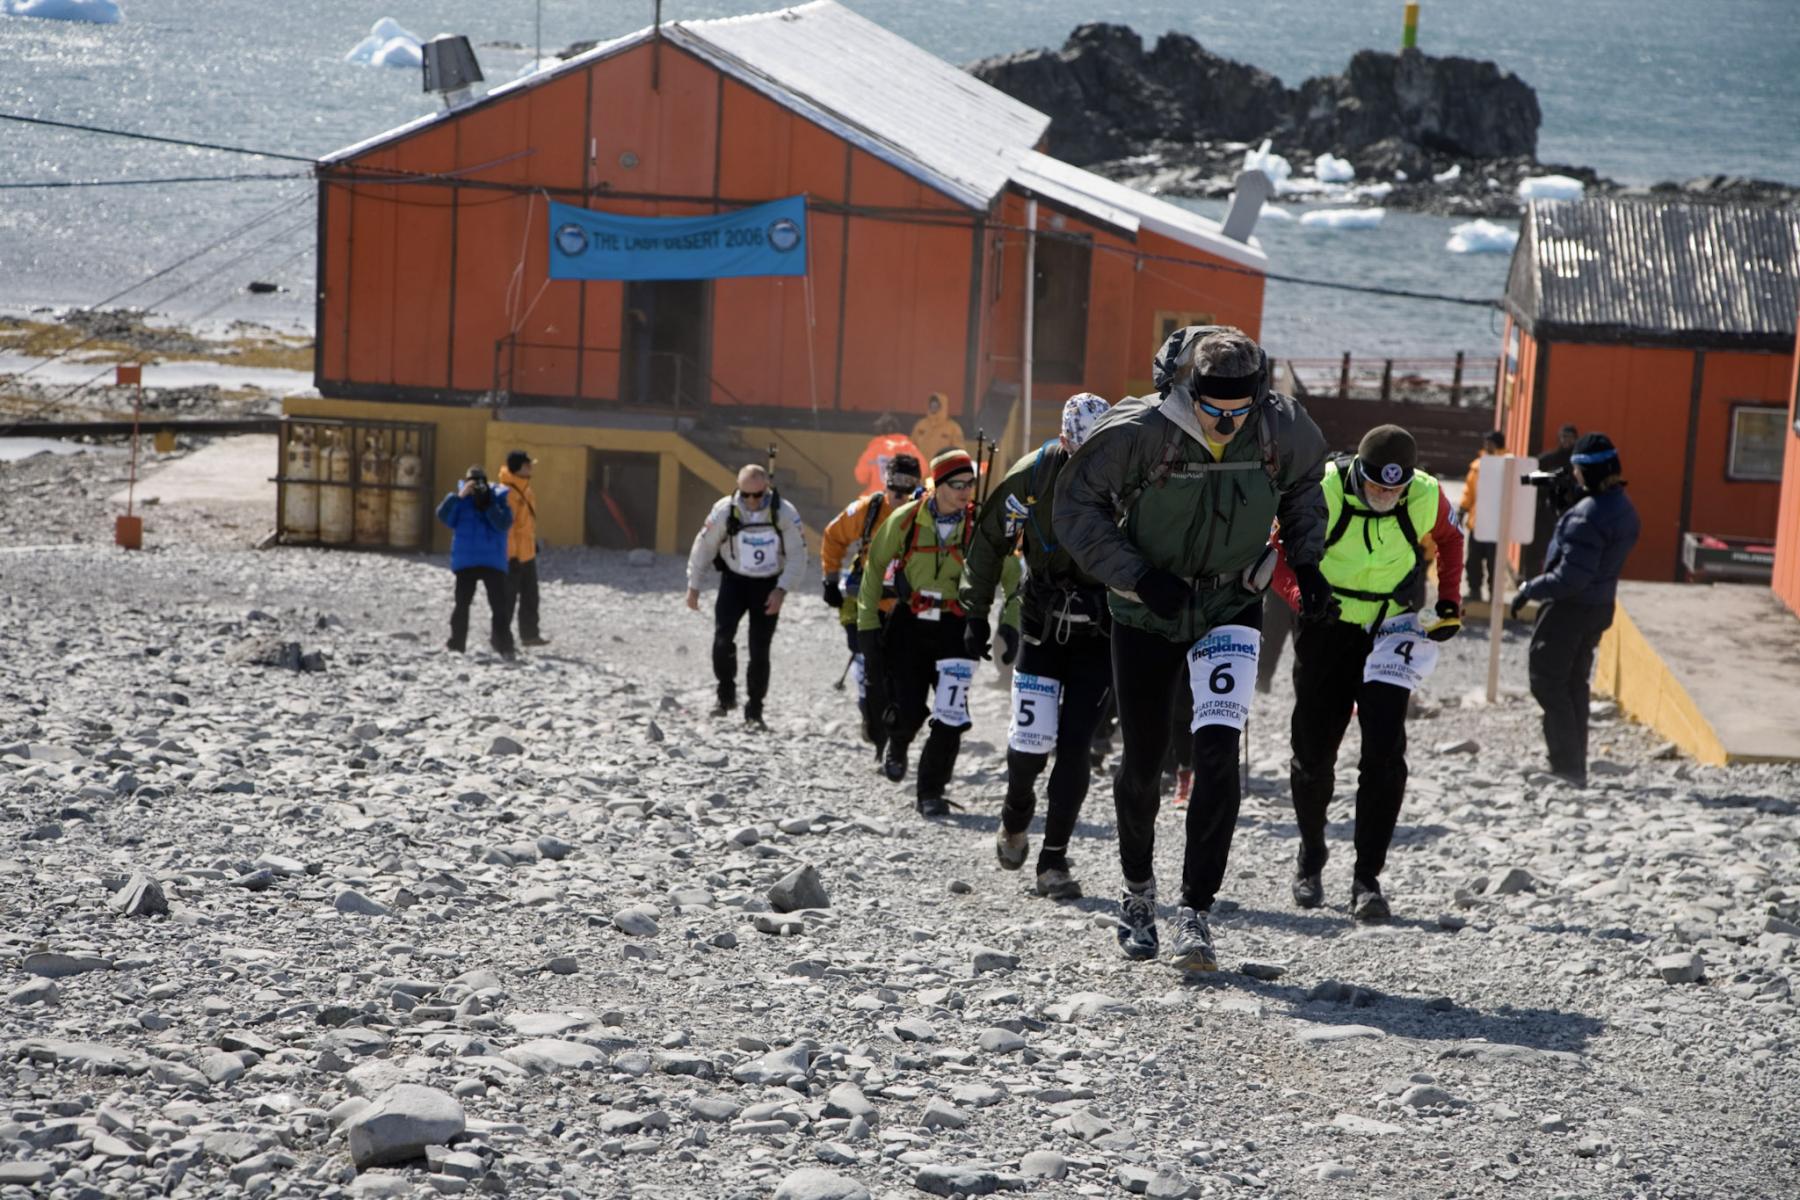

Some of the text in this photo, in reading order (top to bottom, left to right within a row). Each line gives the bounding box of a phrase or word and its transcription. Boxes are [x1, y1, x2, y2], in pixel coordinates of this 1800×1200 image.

[592, 232, 620, 250] THE
[725, 227, 764, 248] 2006
[753, 549, 765, 566] 9
[1394, 640, 1414, 665] 4
[1209, 662, 1235, 695] 6
[1017, 699, 1036, 727] 5
[1214, 700, 1240, 710] DESERT
